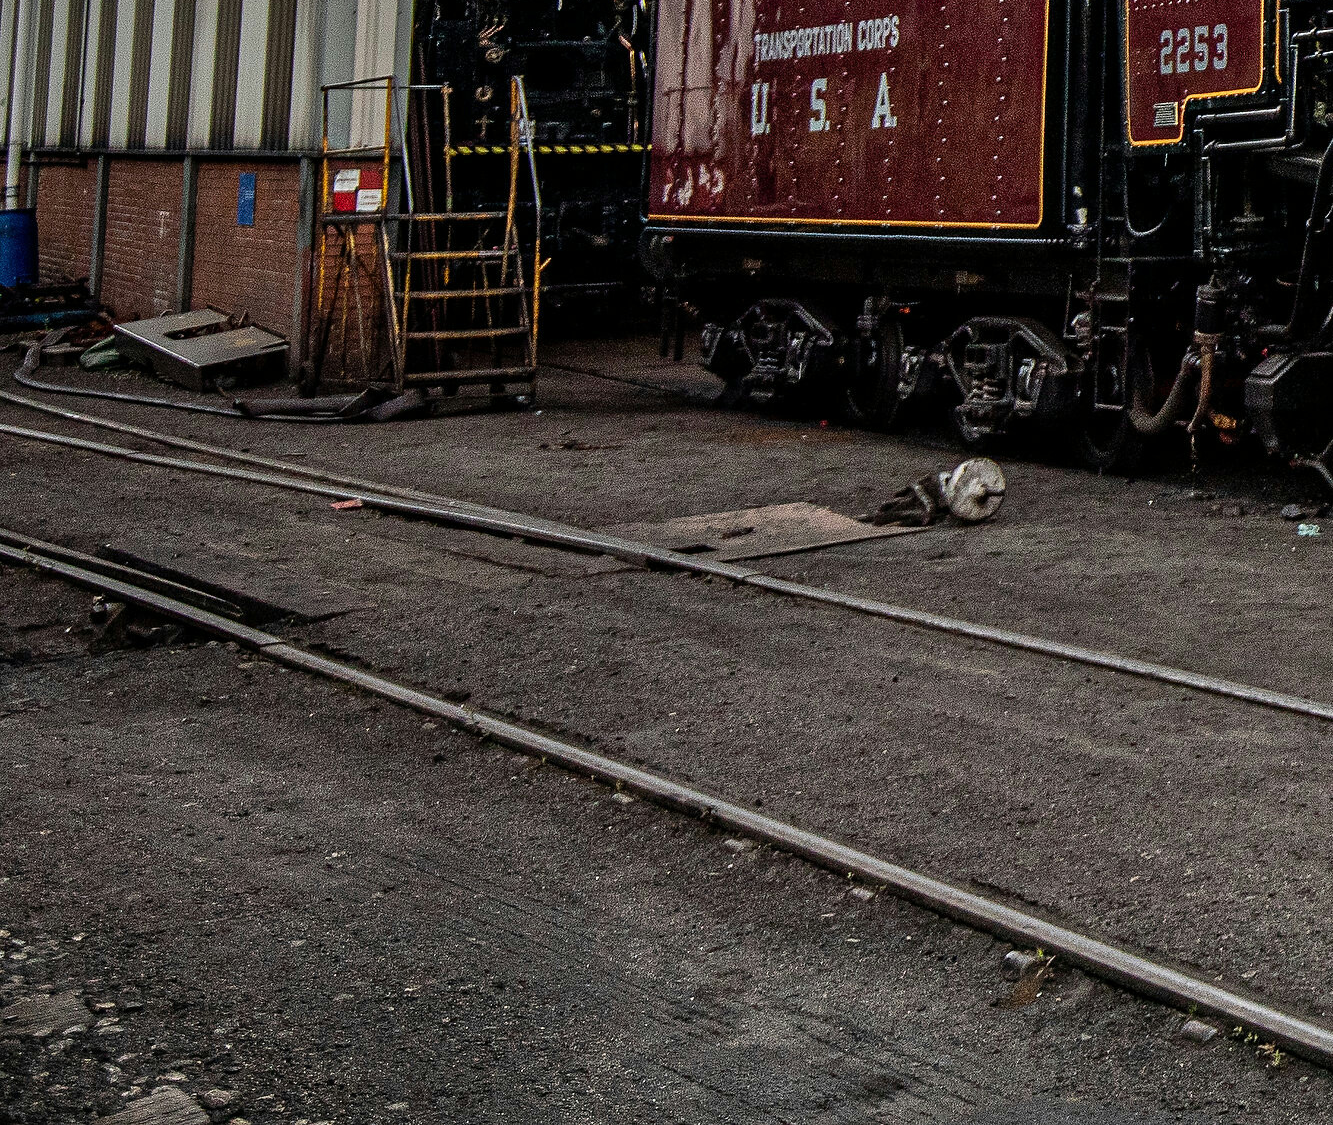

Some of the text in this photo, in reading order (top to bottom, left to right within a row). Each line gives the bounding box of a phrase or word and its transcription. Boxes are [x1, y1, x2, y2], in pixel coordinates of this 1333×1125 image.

[754, 15, 900, 62] TRANSPORTATION CORPS
[1160, 23, 1228, 75] 2253
